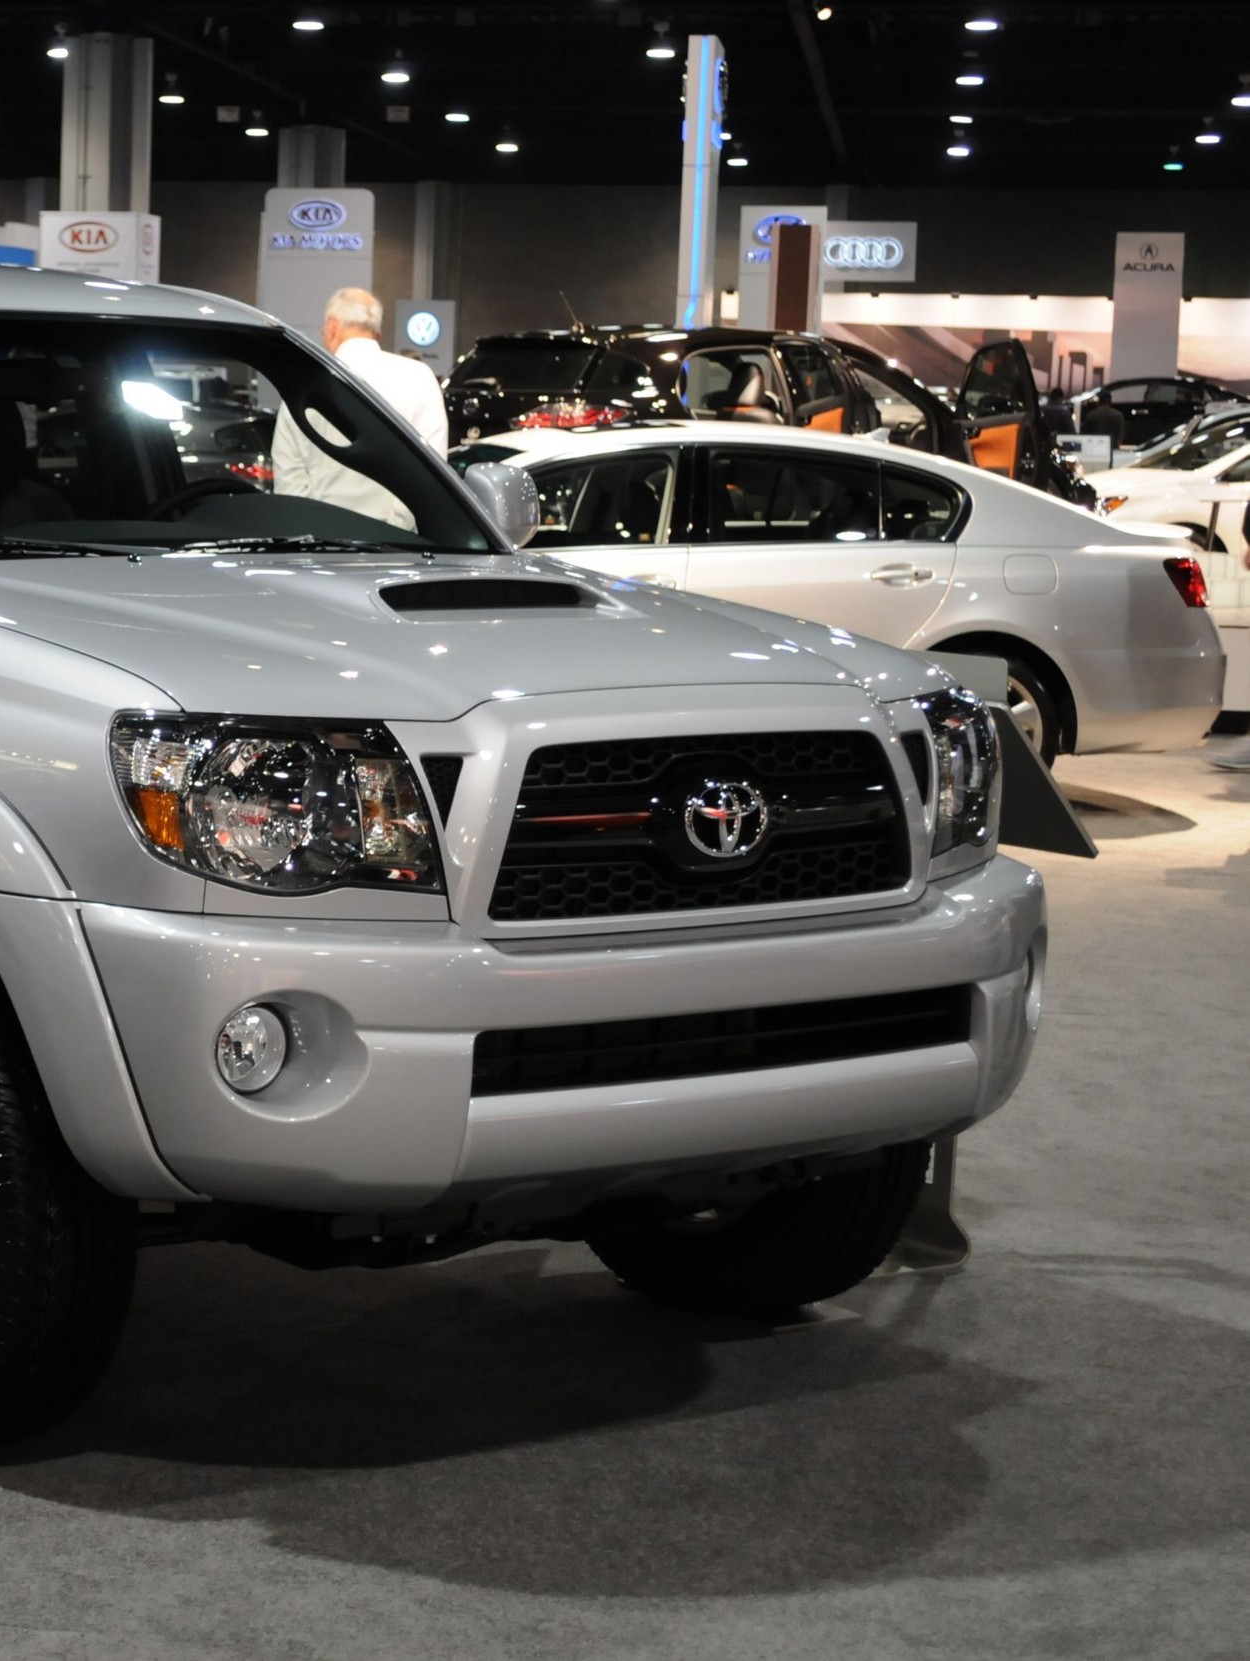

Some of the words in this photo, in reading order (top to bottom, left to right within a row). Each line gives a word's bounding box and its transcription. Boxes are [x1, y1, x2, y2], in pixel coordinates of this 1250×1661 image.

[300, 207, 333, 221] KIA
[70, 229, 108, 245] KIA
[1123, 262, 1175, 272] ACURA
